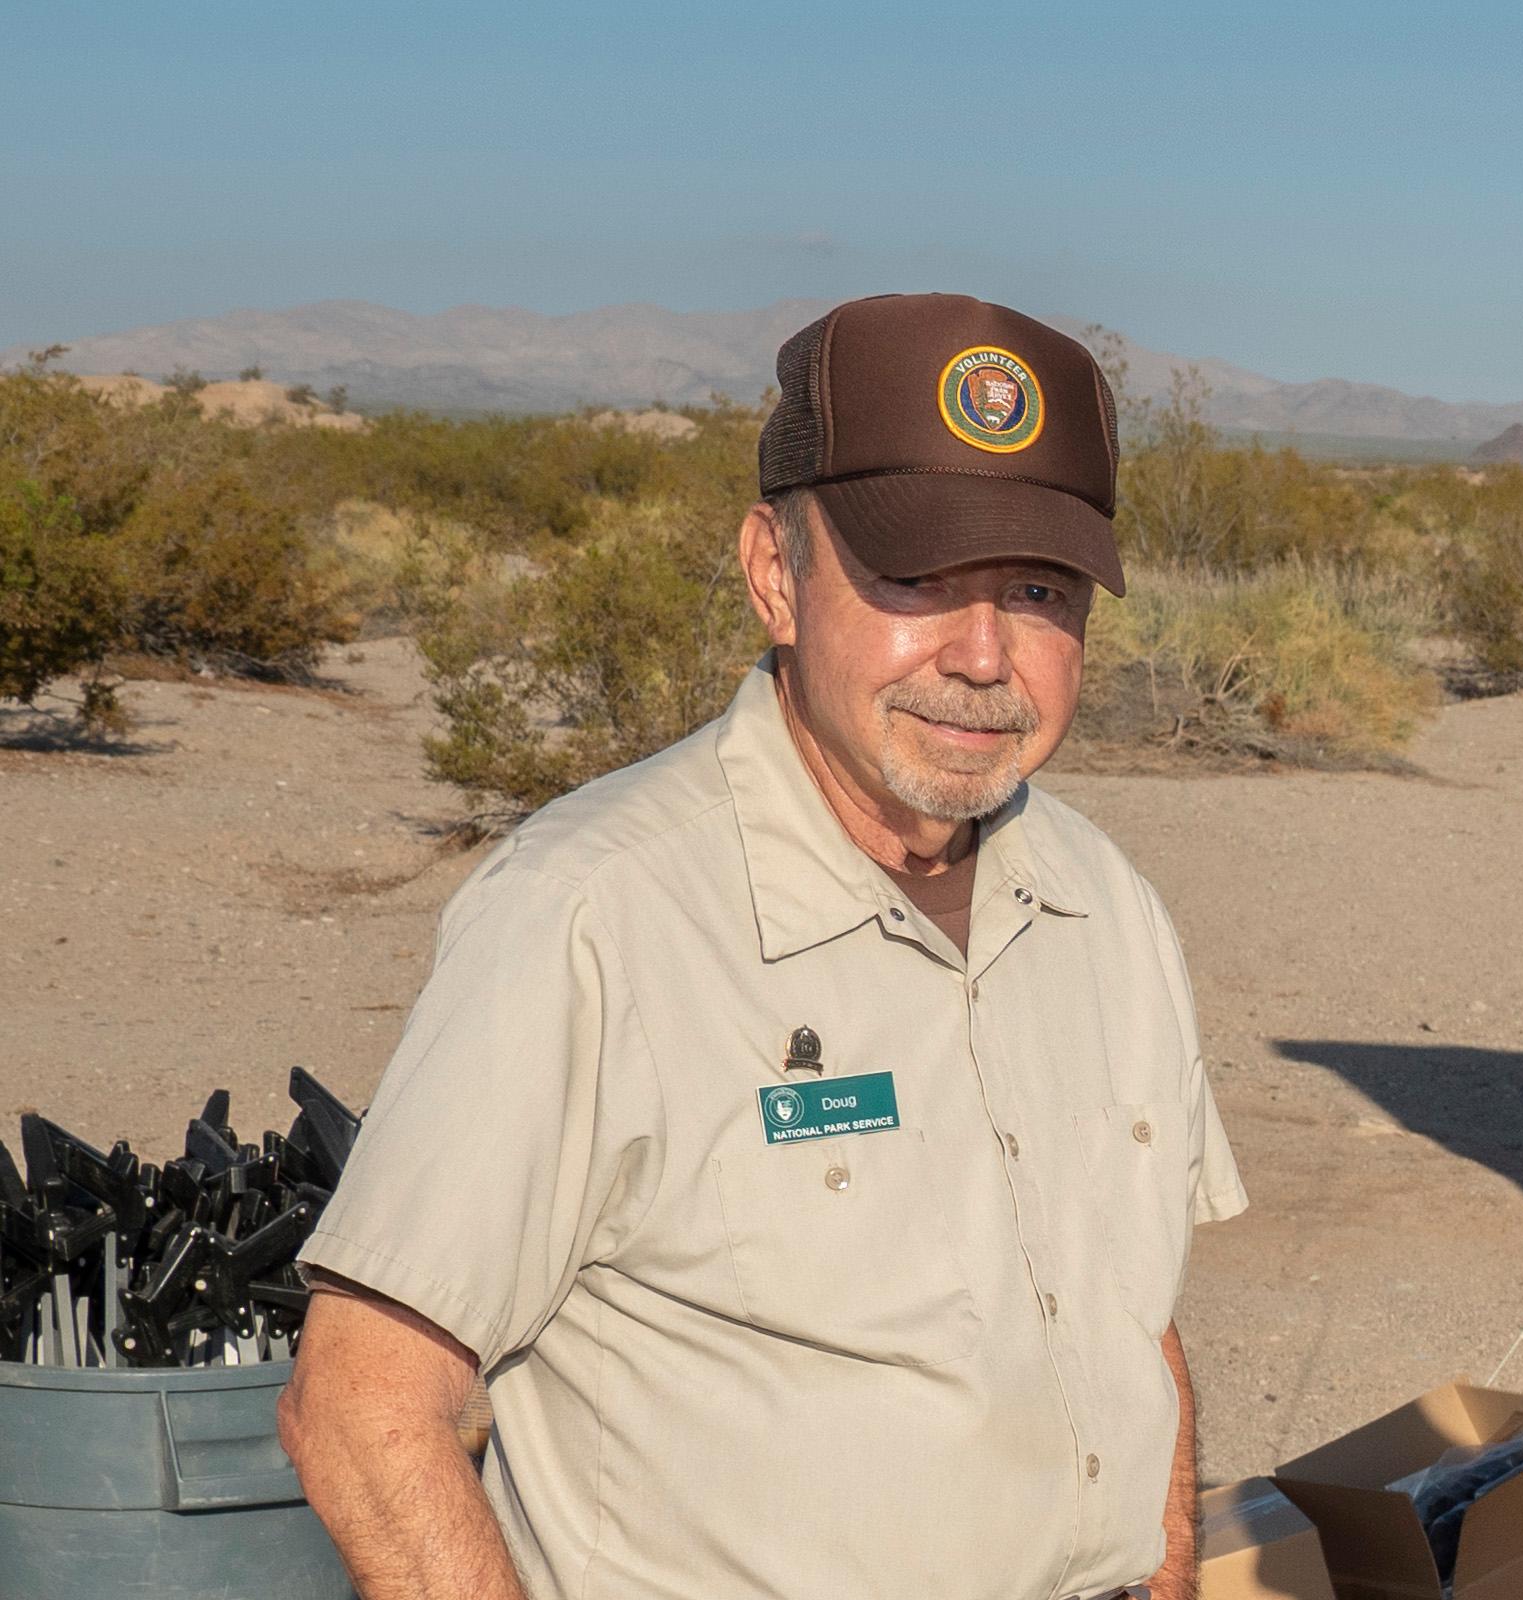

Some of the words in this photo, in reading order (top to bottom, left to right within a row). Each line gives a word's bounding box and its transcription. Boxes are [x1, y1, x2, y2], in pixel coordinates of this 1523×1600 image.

[956, 352, 1028, 381] VOLUNTEER
[821, 1096, 857, 1111] Doug
[773, 1127, 823, 1140] NATIONAL
[824, 1122, 851, 1134] PARK
[852, 1116, 894, 1130] SERVICE
